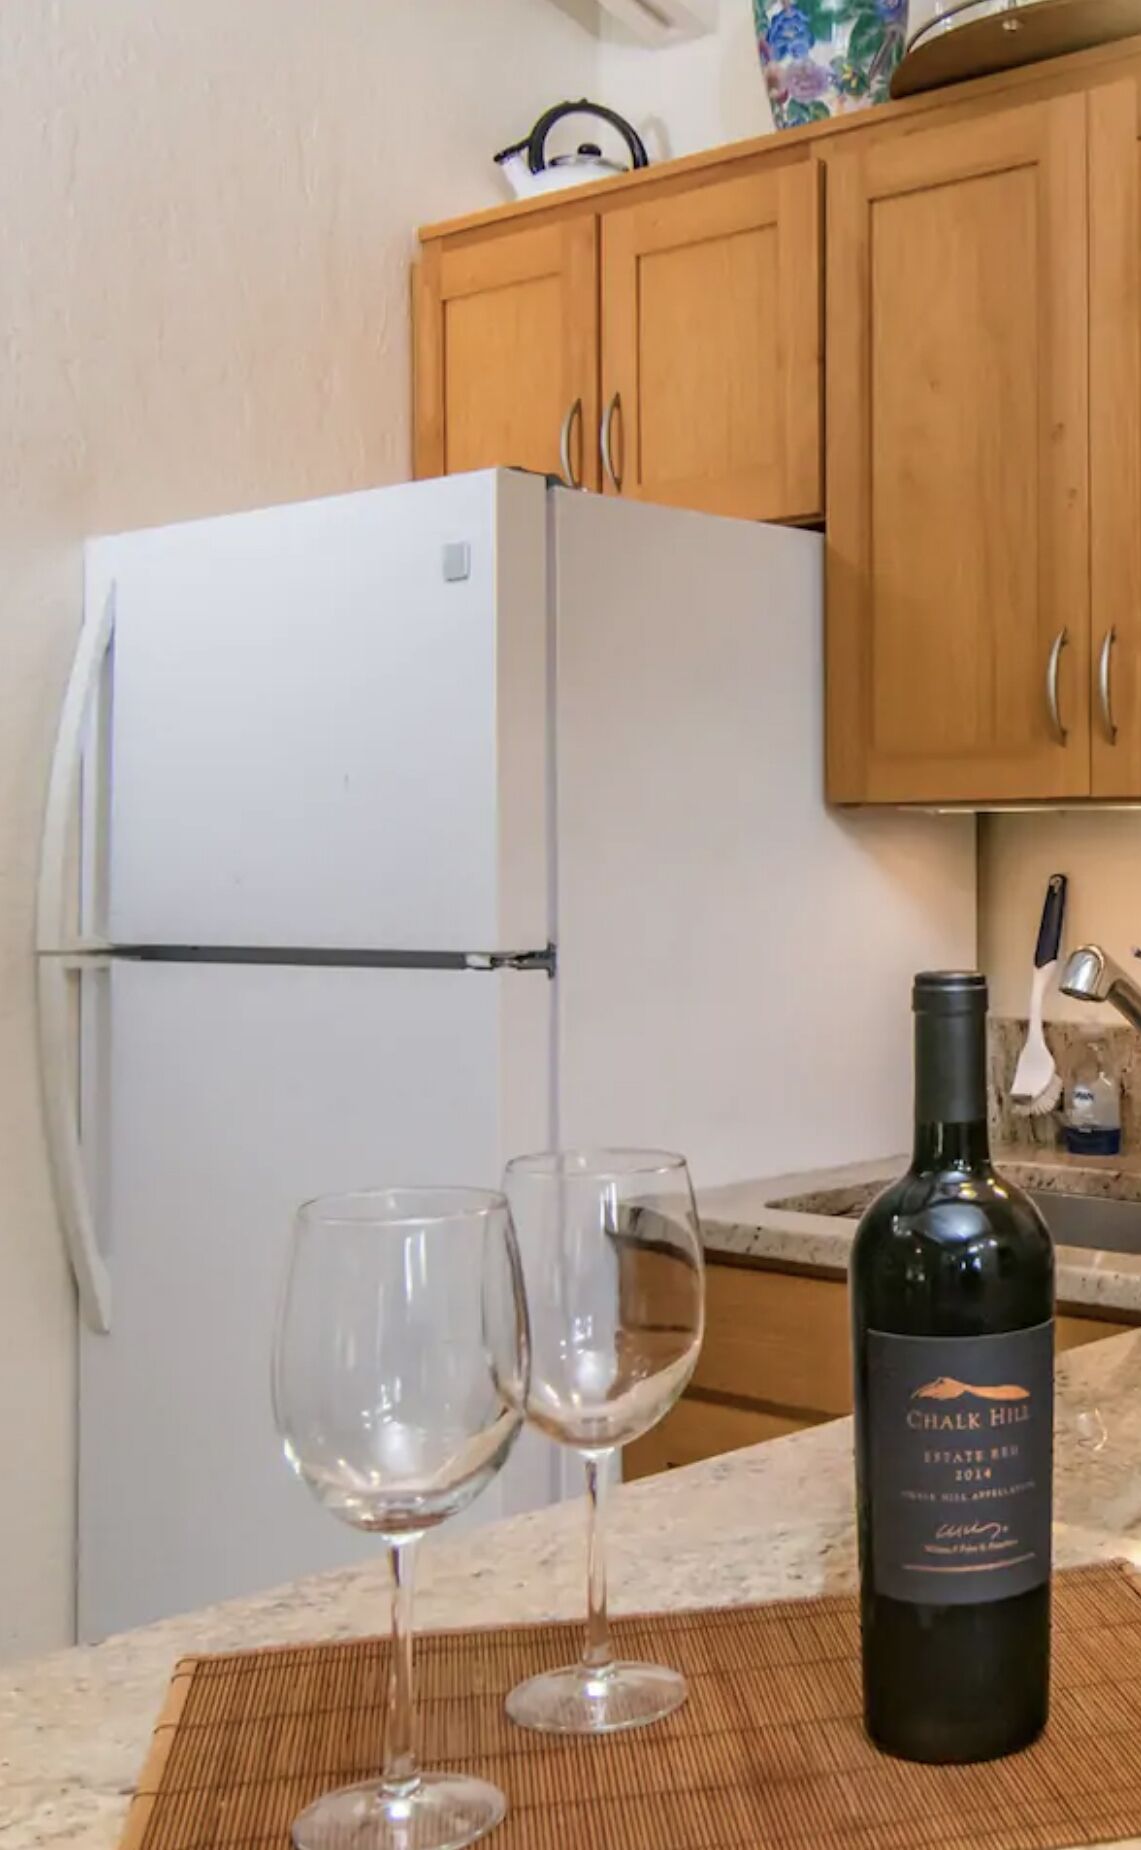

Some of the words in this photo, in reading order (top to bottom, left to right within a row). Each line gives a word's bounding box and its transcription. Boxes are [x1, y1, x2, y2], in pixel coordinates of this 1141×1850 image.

[906, 1410, 980, 1430] CHALK
[990, 1405, 1029, 1426] HILL
[924, 1450, 983, 1462] ESTATE
[955, 1468, 992, 1481] 2014
